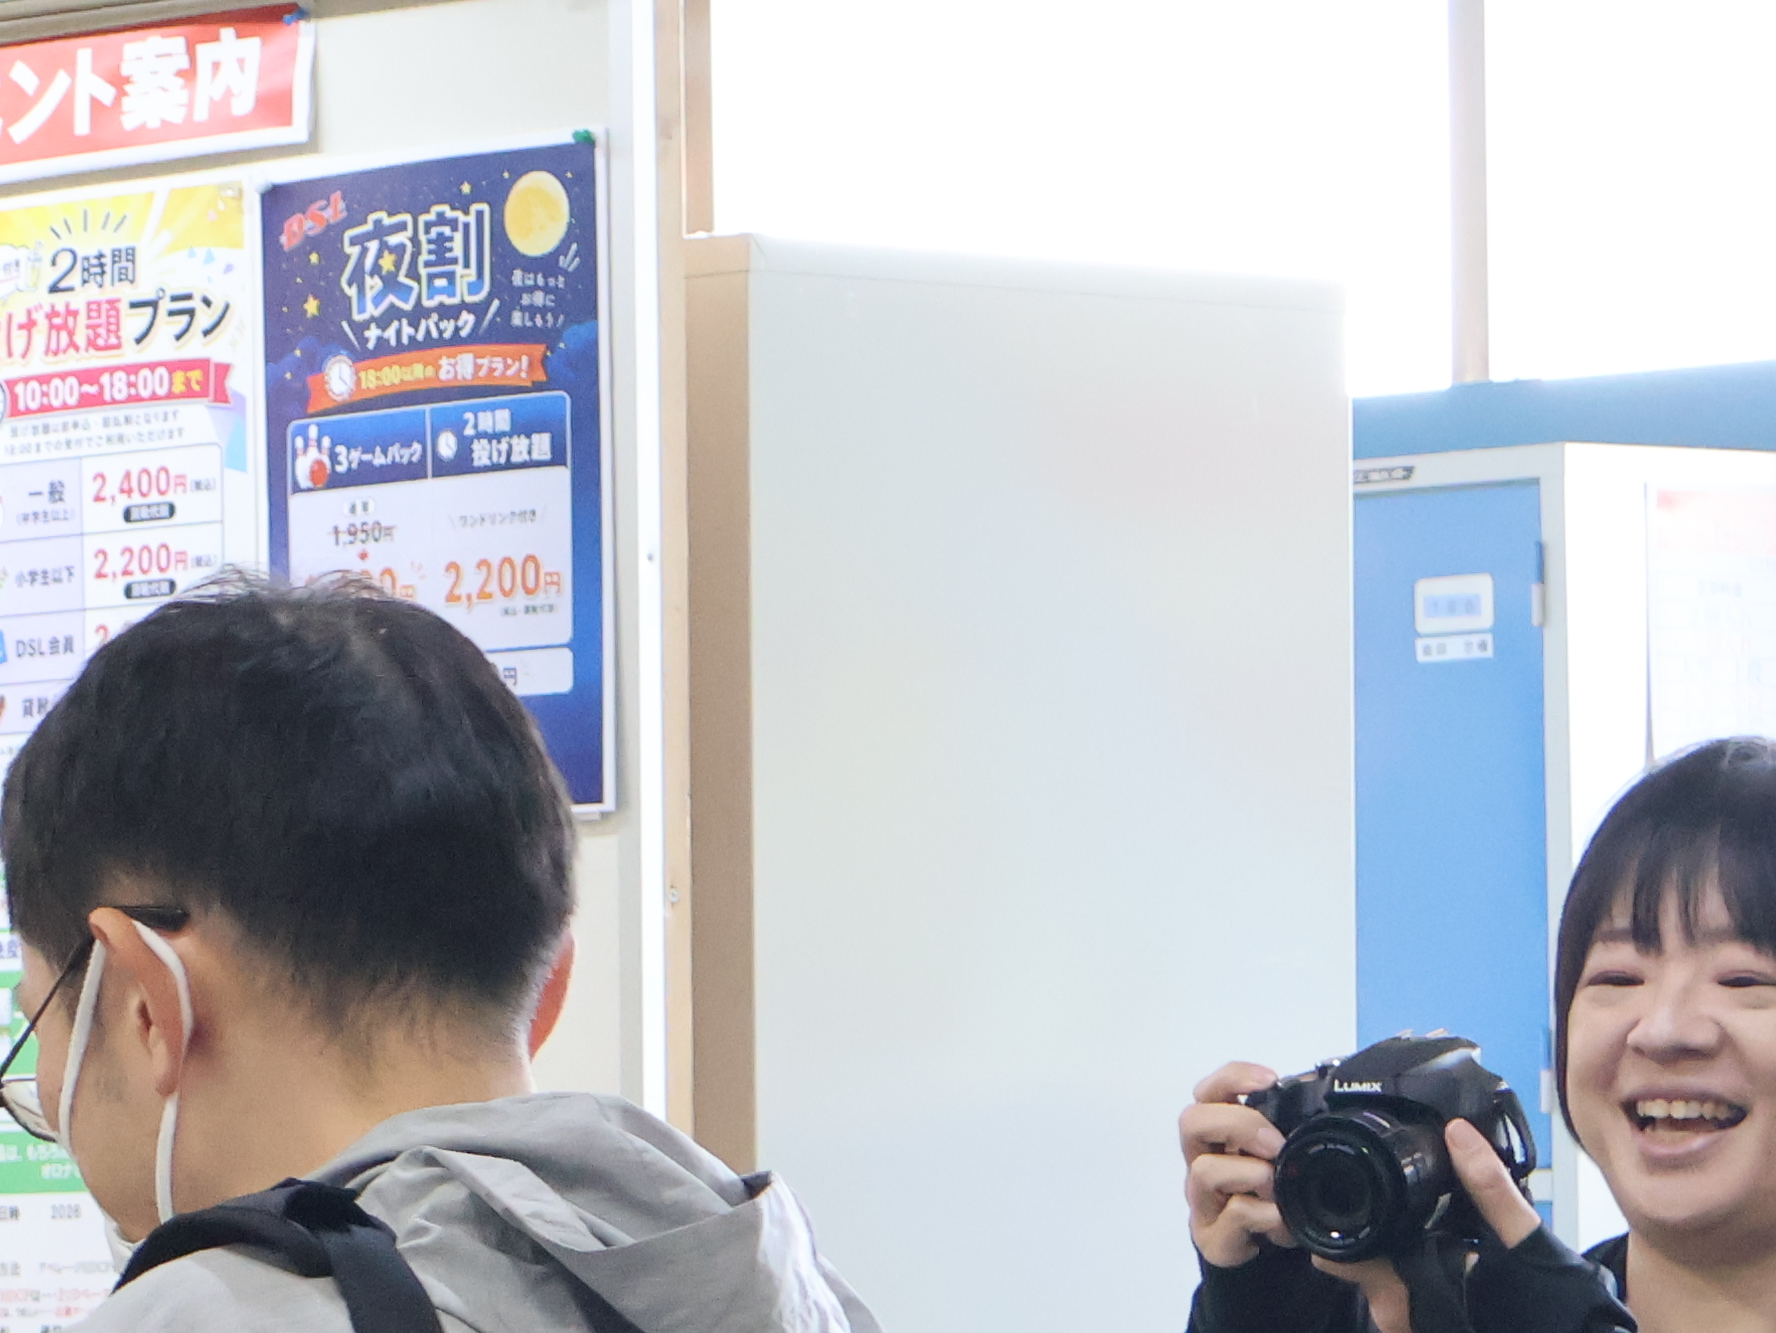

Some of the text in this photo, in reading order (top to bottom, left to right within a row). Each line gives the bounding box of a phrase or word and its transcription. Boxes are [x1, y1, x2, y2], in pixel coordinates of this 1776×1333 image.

[280, 190, 348, 251] DSL
[47, 245, 137, 295] 2時間
[341, 202, 491, 323] 夜割
[363, 309, 477, 350] ナイトパック
[463, 408, 512, 436] 2時間
[334, 440, 423, 475] 3ゲームパック
[470, 432, 552, 466] 投げ放題
[27, 480, 67, 504] 一般
[92, 465, 187, 506] 2,400円
[15, 564, 76, 588] 小学生以下
[93, 542, 188, 583] 2,200円
[444, 553, 562, 615] 2,200円
[1334, 1078, 1383, 1093] LUMIX
